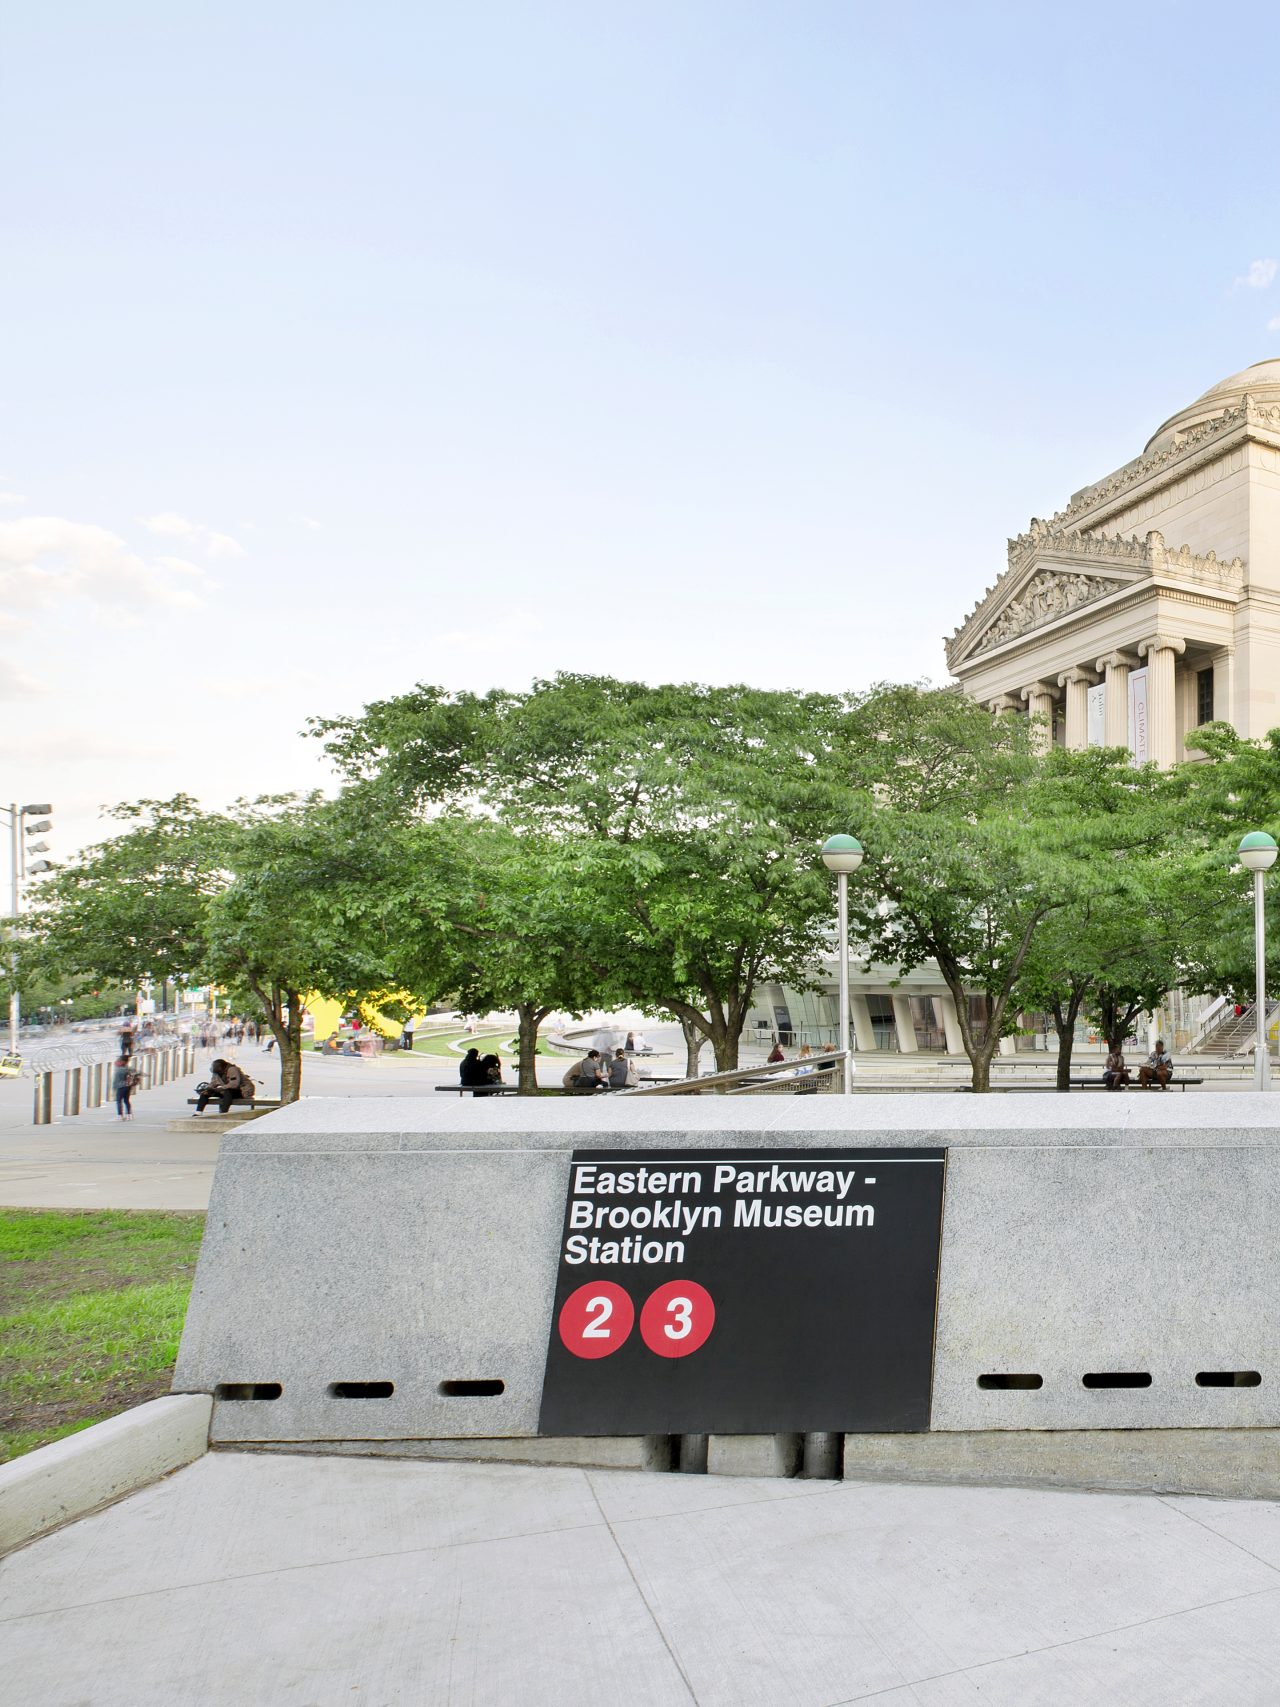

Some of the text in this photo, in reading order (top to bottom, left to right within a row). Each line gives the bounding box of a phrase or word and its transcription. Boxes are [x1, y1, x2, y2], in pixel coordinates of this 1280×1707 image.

[1137, 702, 1146, 756] CLIMATE
[573, 1166, 702, 1195] Eastern
[713, 1164, 856, 1200] Parkway
[569, 1199, 875, 1236] Brooklyn Museum
[564, 1235, 685, 1265] Station
[582, 1296, 693, 1340] 2 3
